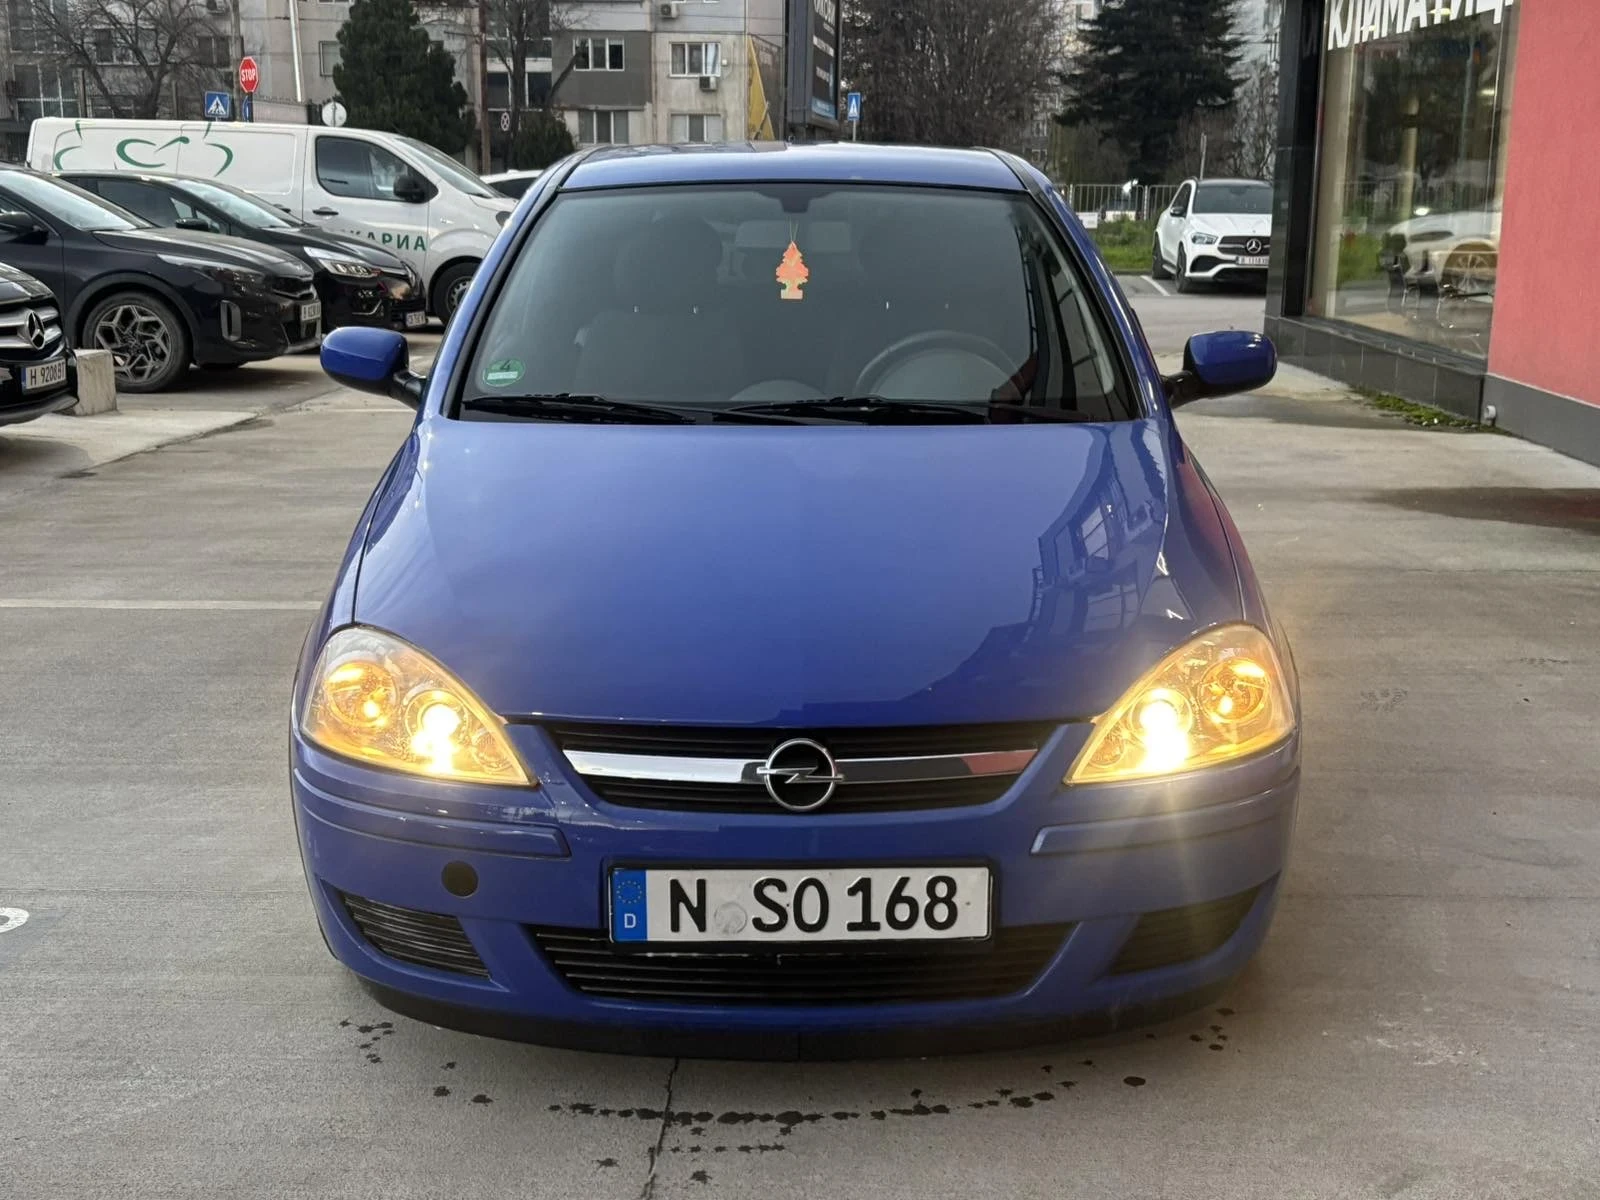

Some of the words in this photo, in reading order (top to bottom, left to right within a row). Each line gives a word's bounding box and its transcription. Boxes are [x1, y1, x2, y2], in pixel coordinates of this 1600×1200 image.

[241, 68, 256, 82] STOP
[500, 360, 511, 372] 4
[669, 878, 707, 933] N
[752, 877, 829, 933] SO
[846, 875, 958, 931] 168
[624, 913, 637, 928] D
